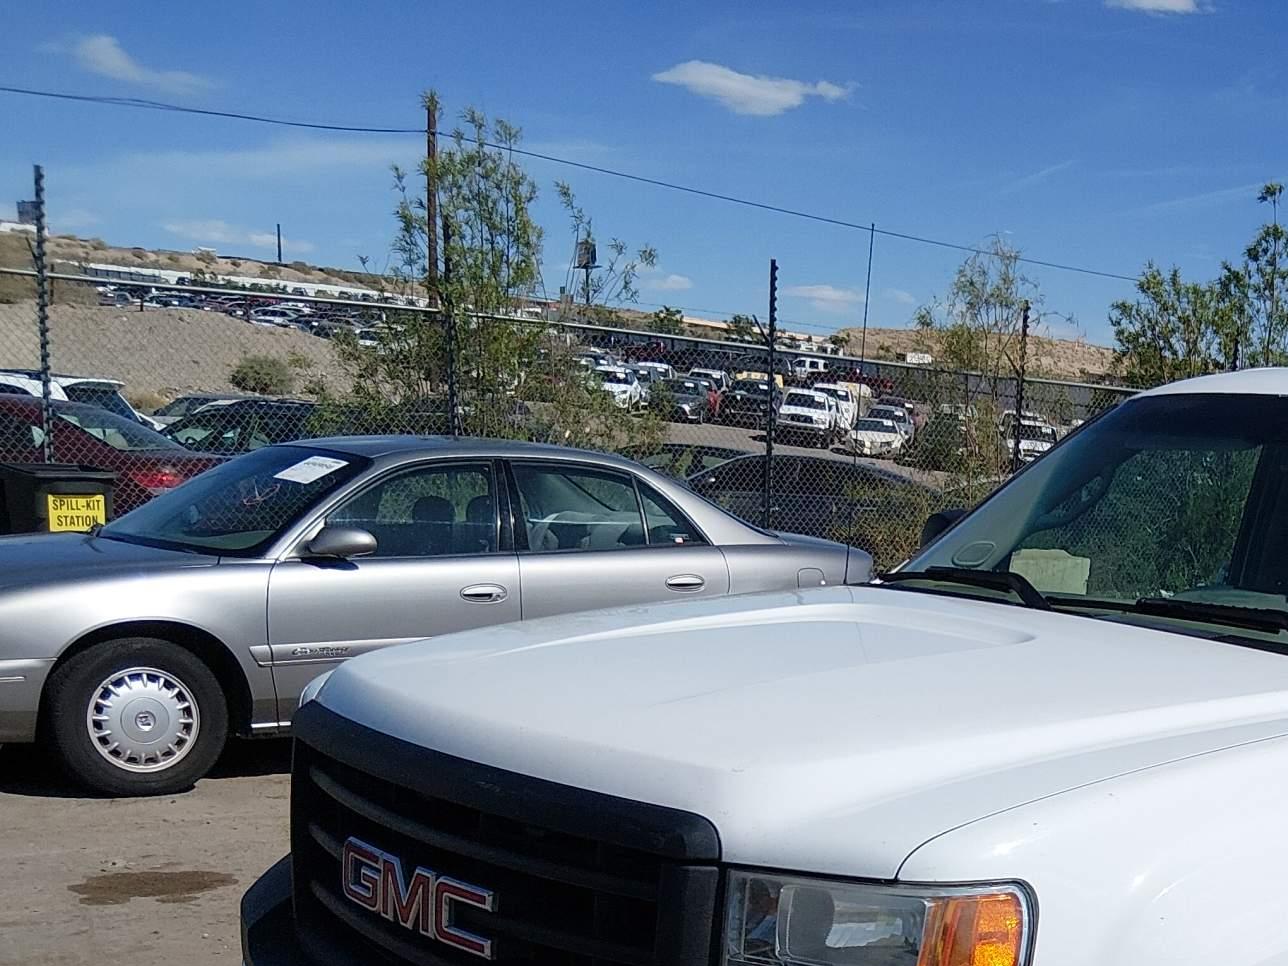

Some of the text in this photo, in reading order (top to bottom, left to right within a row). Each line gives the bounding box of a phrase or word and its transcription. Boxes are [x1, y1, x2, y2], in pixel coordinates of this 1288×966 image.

[52, 499, 102, 511] SPILL-KIT
[56, 514, 98, 527] STATION
[343, 836, 495, 960] GMC
